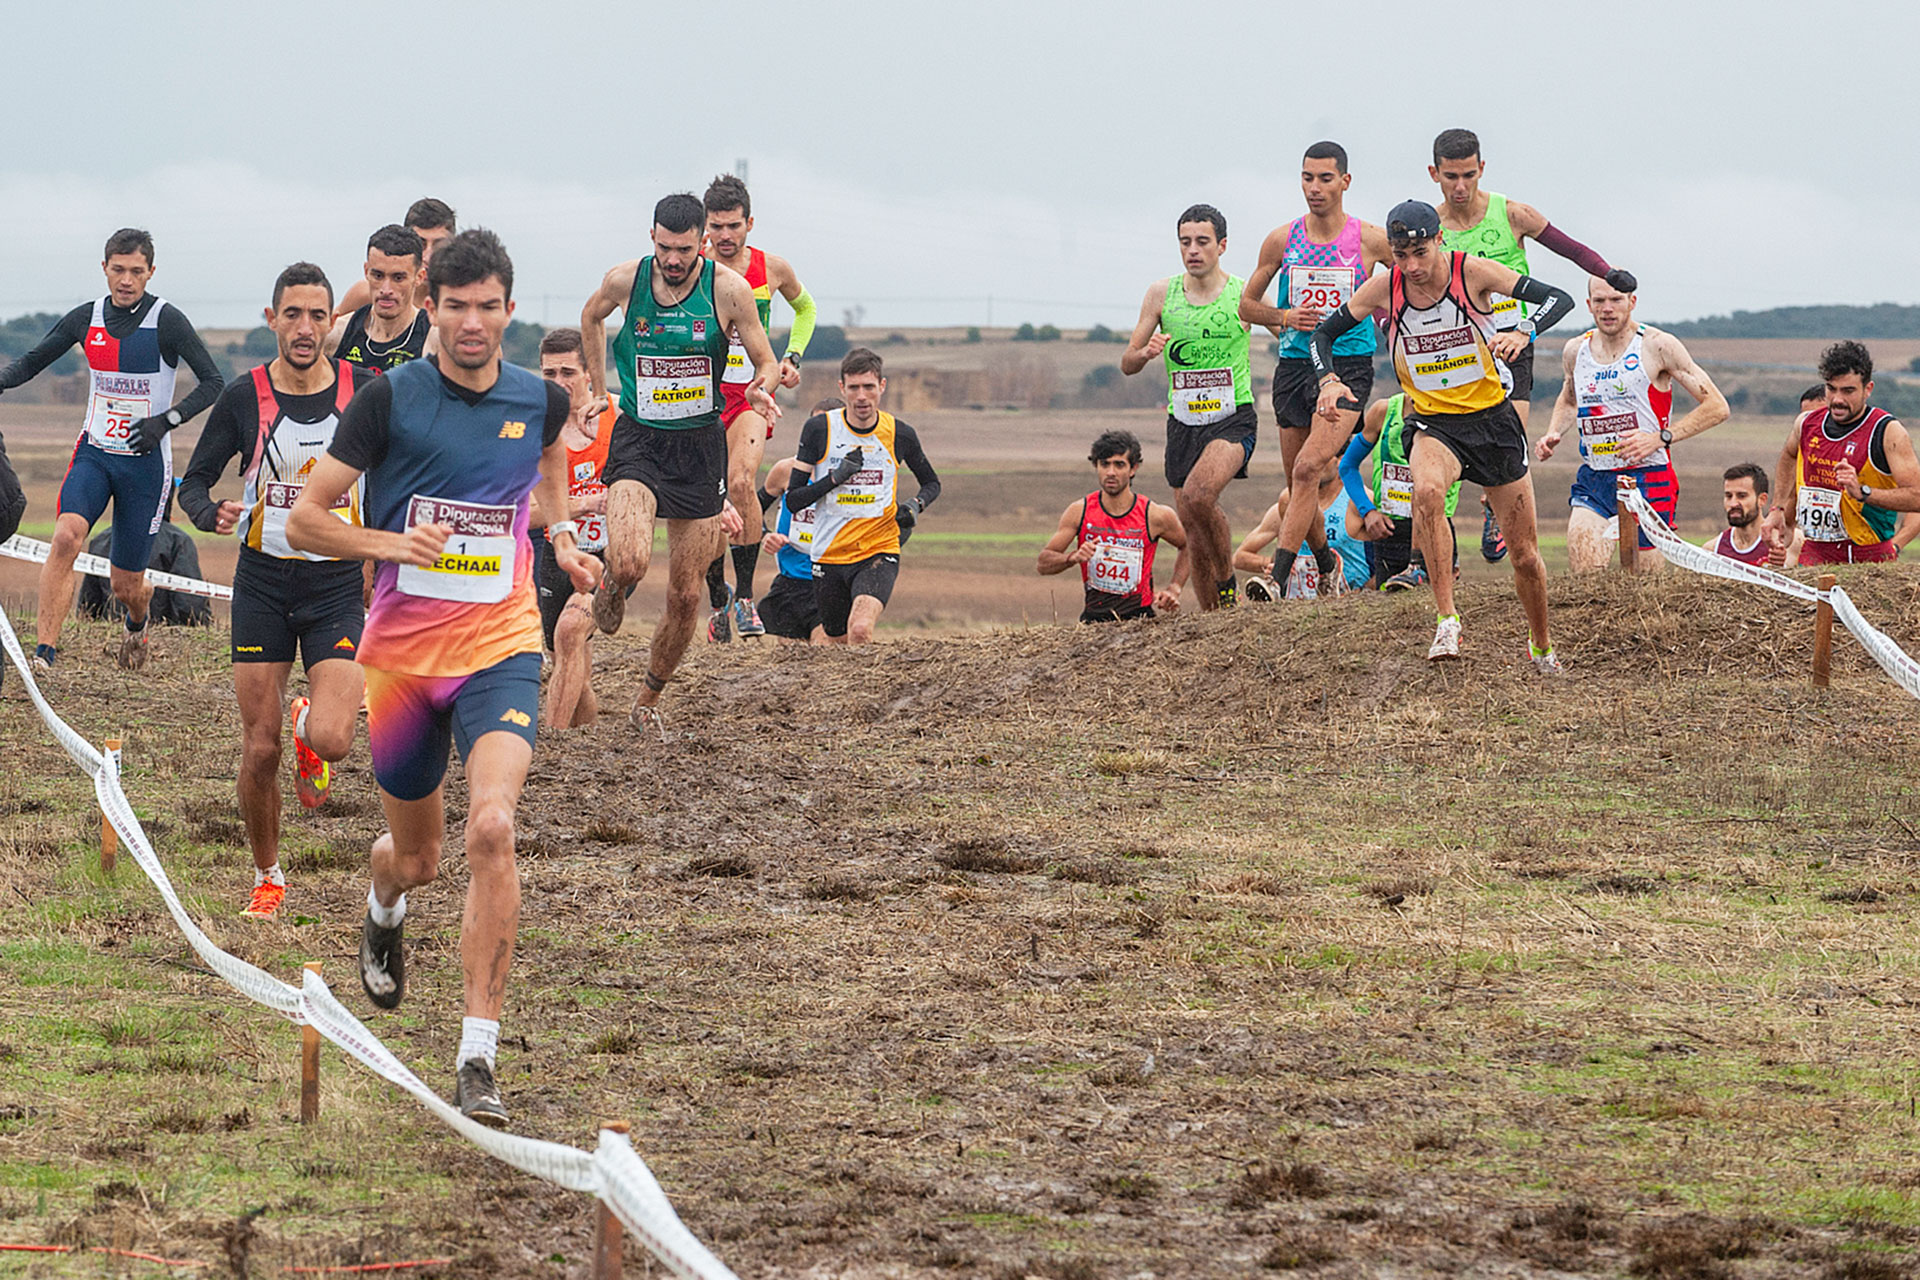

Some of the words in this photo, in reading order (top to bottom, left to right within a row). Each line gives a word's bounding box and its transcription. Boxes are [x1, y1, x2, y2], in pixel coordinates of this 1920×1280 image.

[1301, 289, 1341, 308] 293
[1420, 330, 1468, 345] Diputación
[1421, 343, 1433, 351] de
[1434, 338, 1469, 349] Segovia
[1434, 353, 1449, 362] 22
[655, 359, 705, 369] Diputación
[1416, 356, 1477, 373] FERNANDEZ
[655, 368, 665, 376] de
[670, 367, 705, 377] Segovia
[1186, 371, 1227, 381] Diputación
[1595, 370, 1618, 380] aula
[671, 383, 679, 391] 2
[1198, 379, 1228, 387] Segovia
[652, 388, 705, 401] CATROFE
[1196, 393, 1209, 401] 15
[1188, 402, 1221, 411] BRAVO
[1593, 415, 1633, 428] Diputación
[105, 418, 131, 439] 25
[1605, 436, 1617, 444] 21
[1592, 445, 1617, 453] GONZ
[1387, 491, 1410, 501] OUKH
[439, 505, 507, 523] Diputación
[459, 522, 505, 536] Segovia
[574, 519, 601, 541] 75
[458, 542, 467, 554] 1
[433, 557, 500, 572] ECHAAL
[1096, 562, 1130, 582] 944
